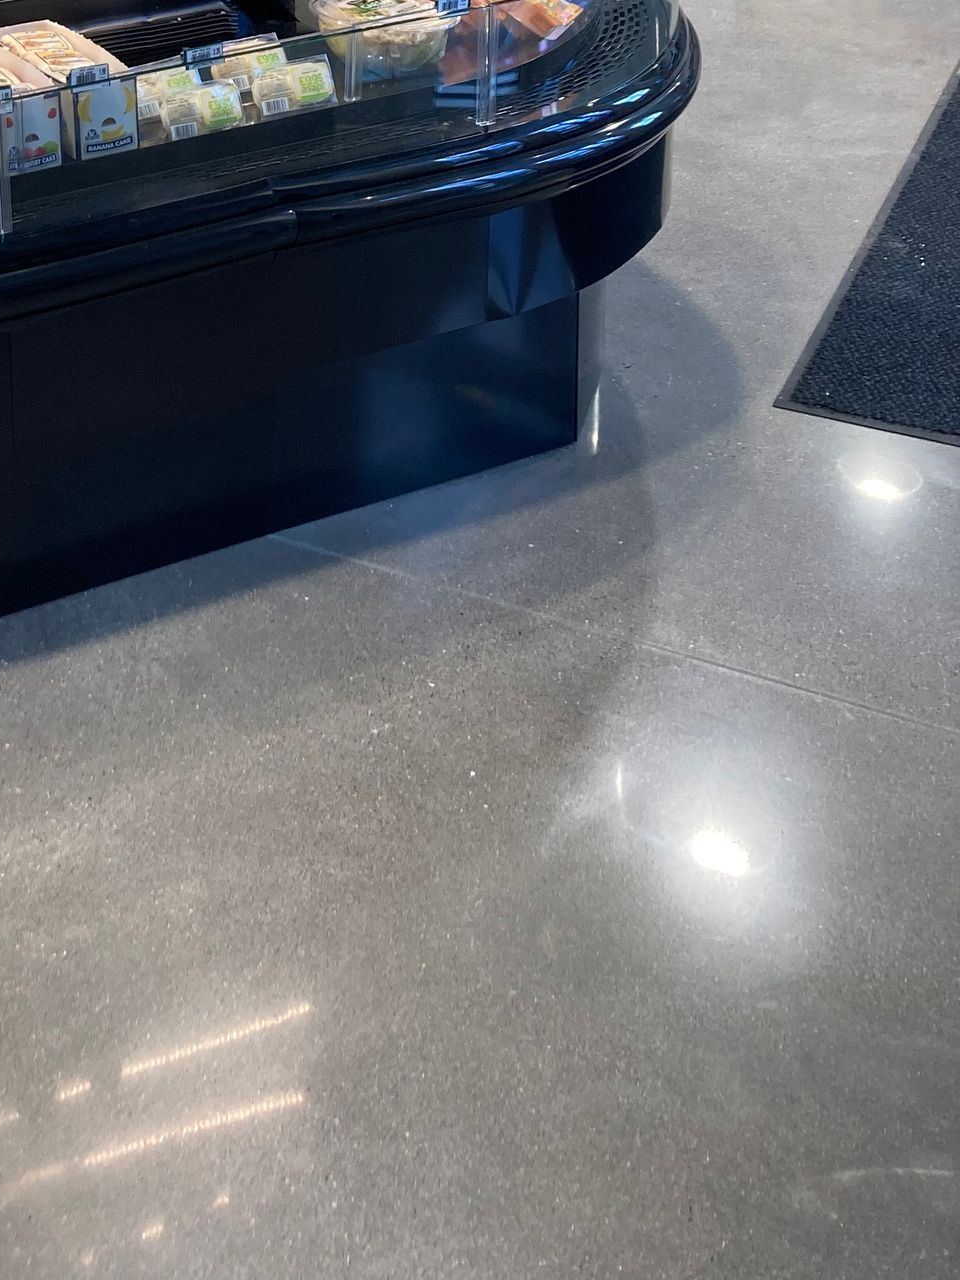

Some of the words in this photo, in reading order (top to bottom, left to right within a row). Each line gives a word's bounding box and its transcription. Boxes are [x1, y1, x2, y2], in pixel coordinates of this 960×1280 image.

[299, 73, 324, 87] Eggs
[87, 141, 115, 153] BANANA
[114, 136, 133, 148] CAKE
[41, 154, 57, 165] CAKE
